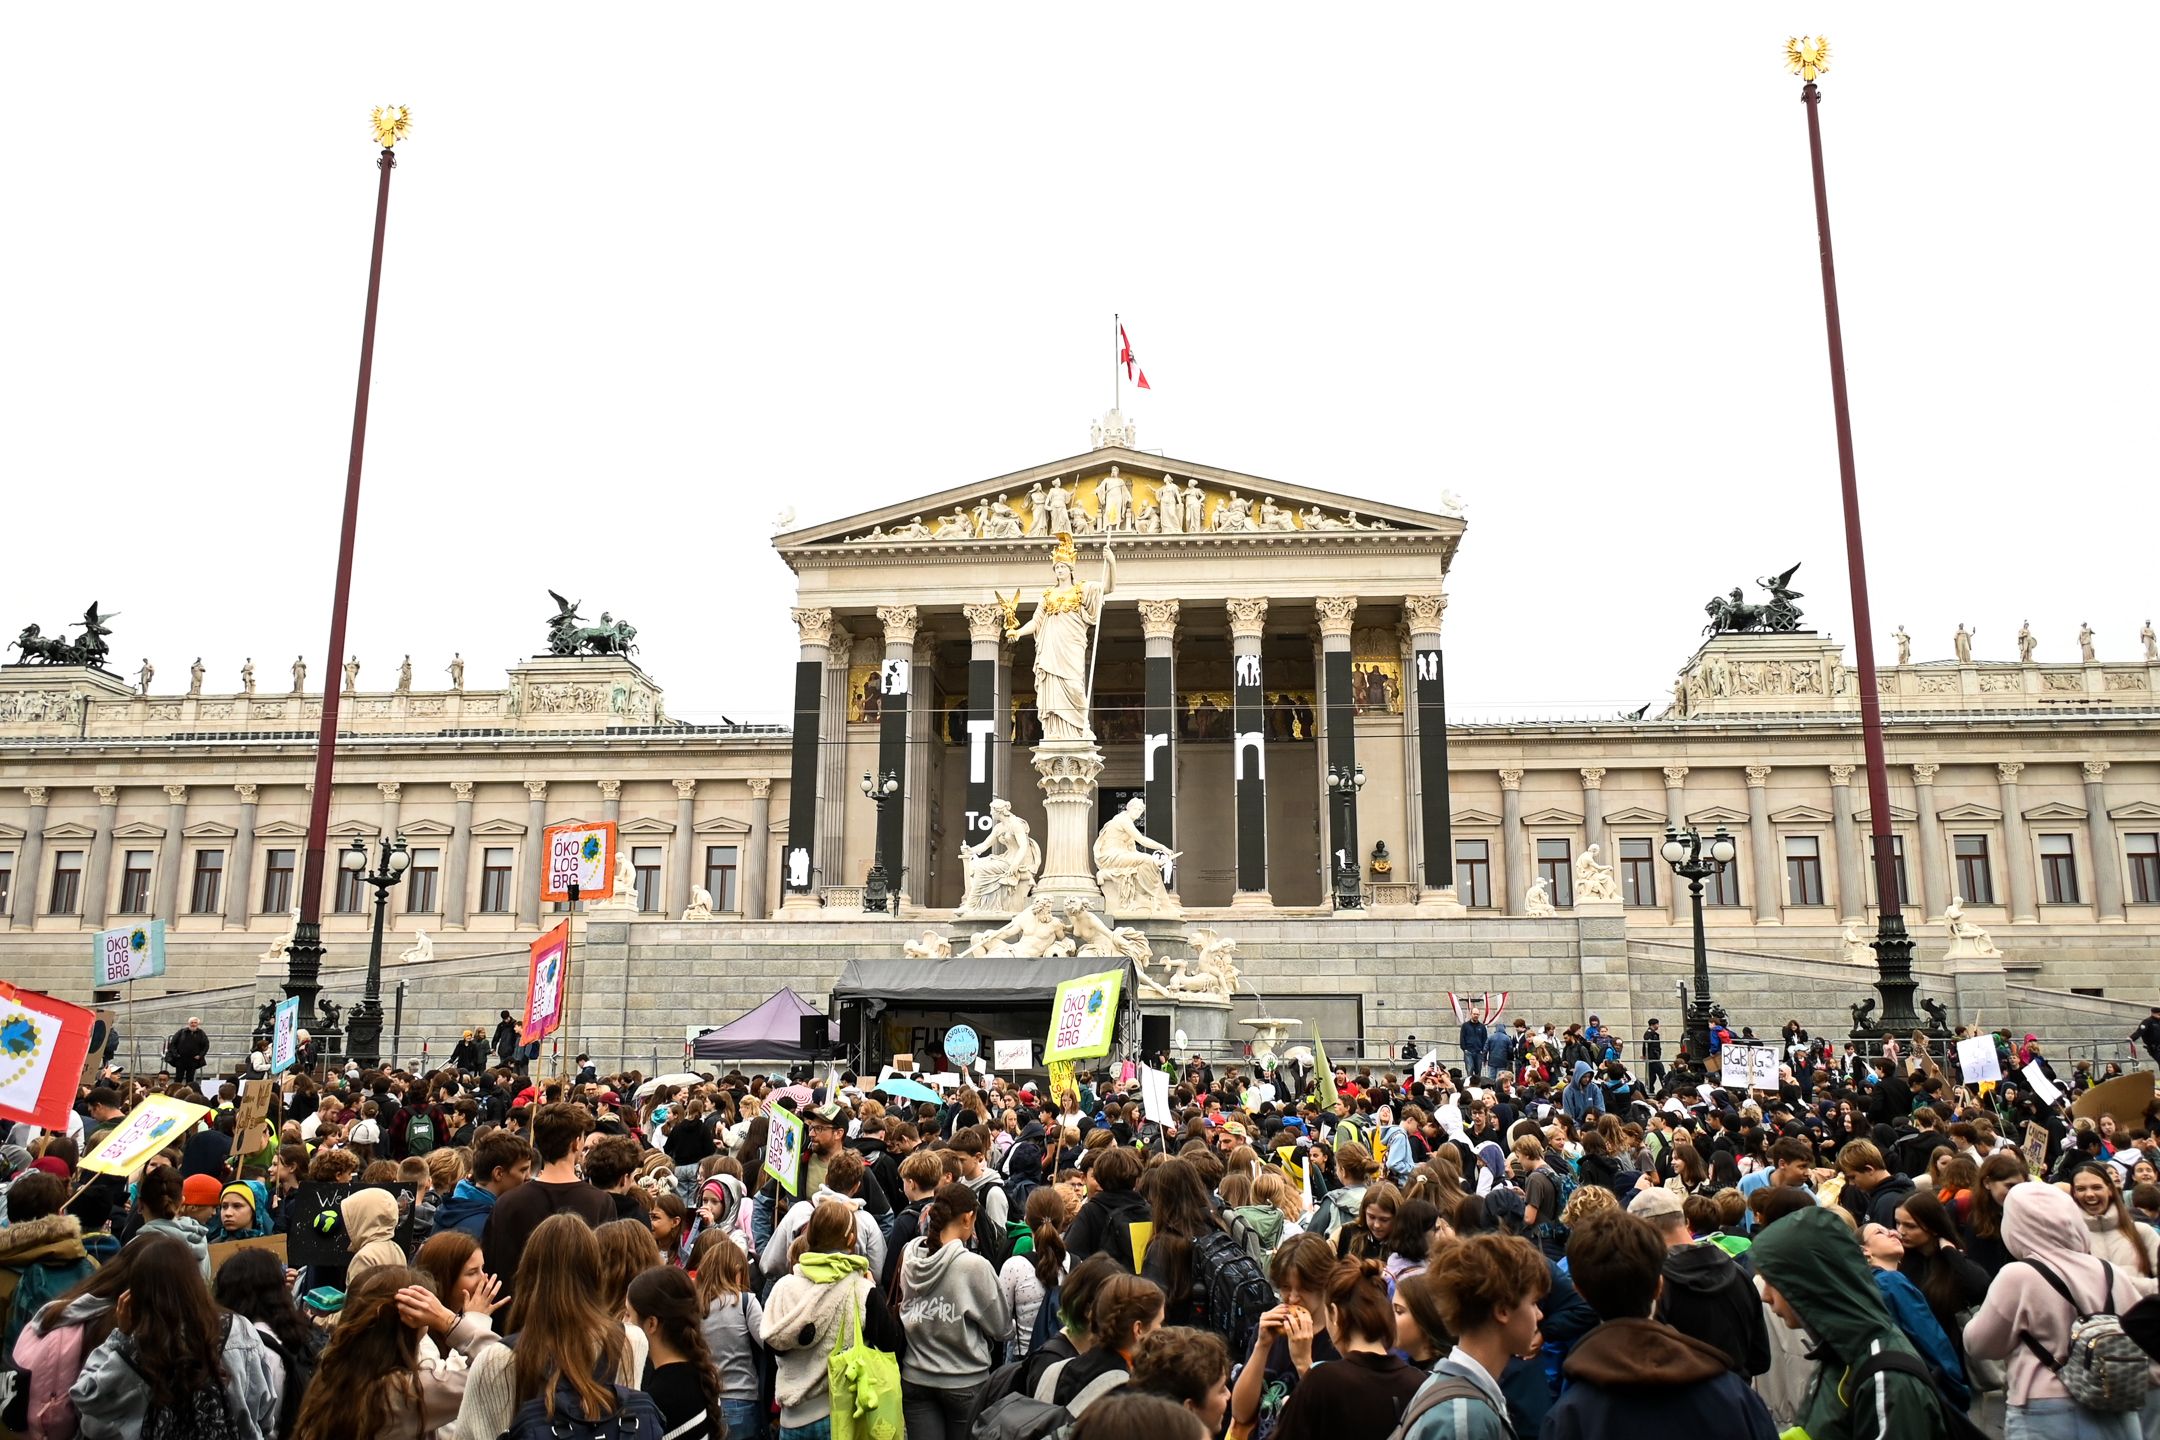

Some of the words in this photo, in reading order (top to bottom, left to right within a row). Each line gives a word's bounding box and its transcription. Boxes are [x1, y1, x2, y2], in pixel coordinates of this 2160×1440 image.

[965, 811, 993, 831] To
[554, 838, 580, 857] ÖKO
[553, 857, 579, 873] LOG
[552, 873, 579, 889] BRG
[106, 936, 129, 952] ÖKO
[107, 950, 129, 966] LOG
[107, 964, 130, 980] BRG
[1063, 993, 1086, 1013] ÖKO
[1060, 1012, 1083, 1031] LOG
[946, 1027, 976, 1042] REVOLUTION
[1057, 1029, 1080, 1048] BRG
[133, 1110, 160, 1128] ÖKO
[771, 1115, 785, 1141] ÖKO
[770, 1134, 783, 1156] LOG
[768, 1150, 782, 1172] BRG
